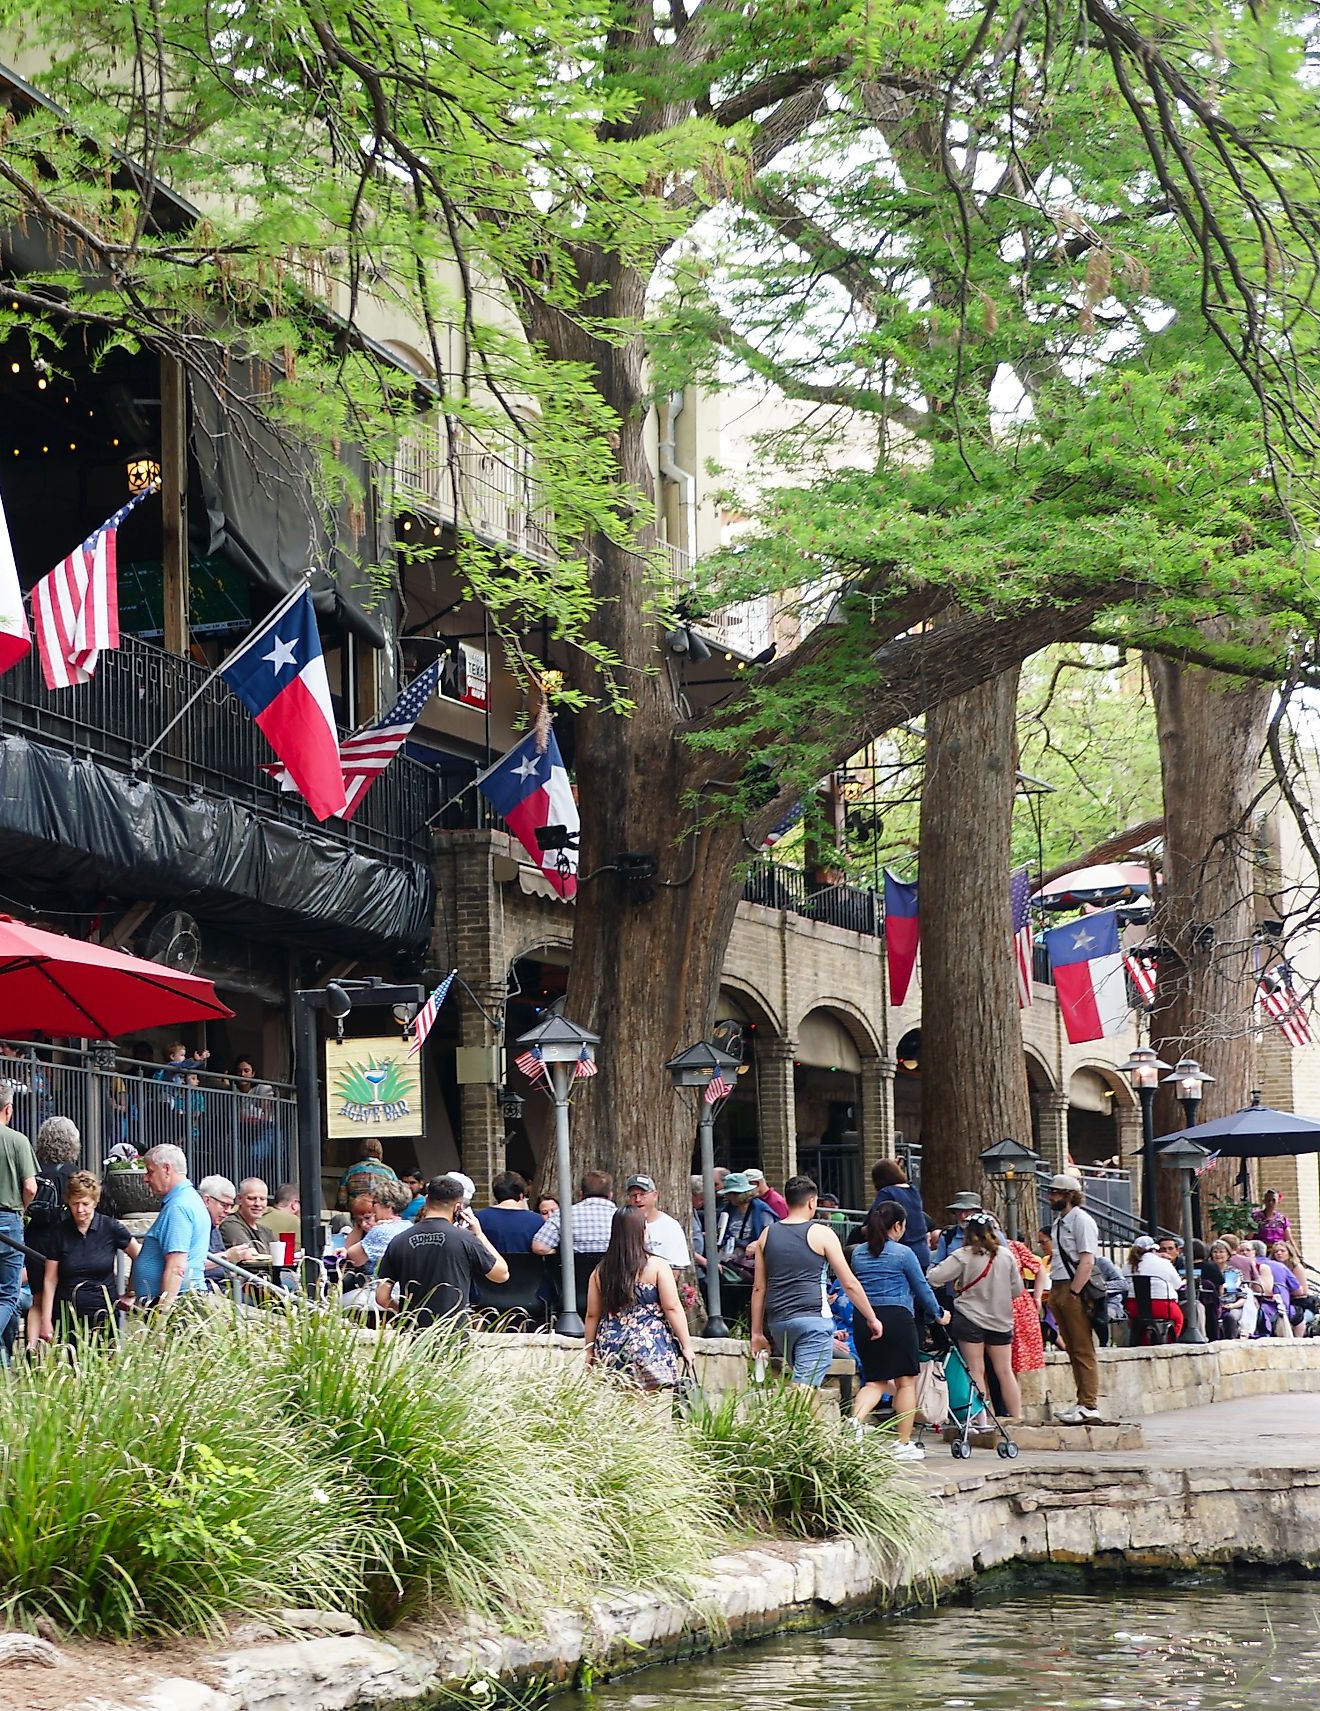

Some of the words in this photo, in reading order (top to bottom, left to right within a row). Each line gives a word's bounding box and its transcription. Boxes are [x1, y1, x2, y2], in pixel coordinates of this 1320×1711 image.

[468, 660, 486, 679] TEXA
[337, 1101, 380, 1123] AGAVE
[382, 1100, 410, 1121] BAR
